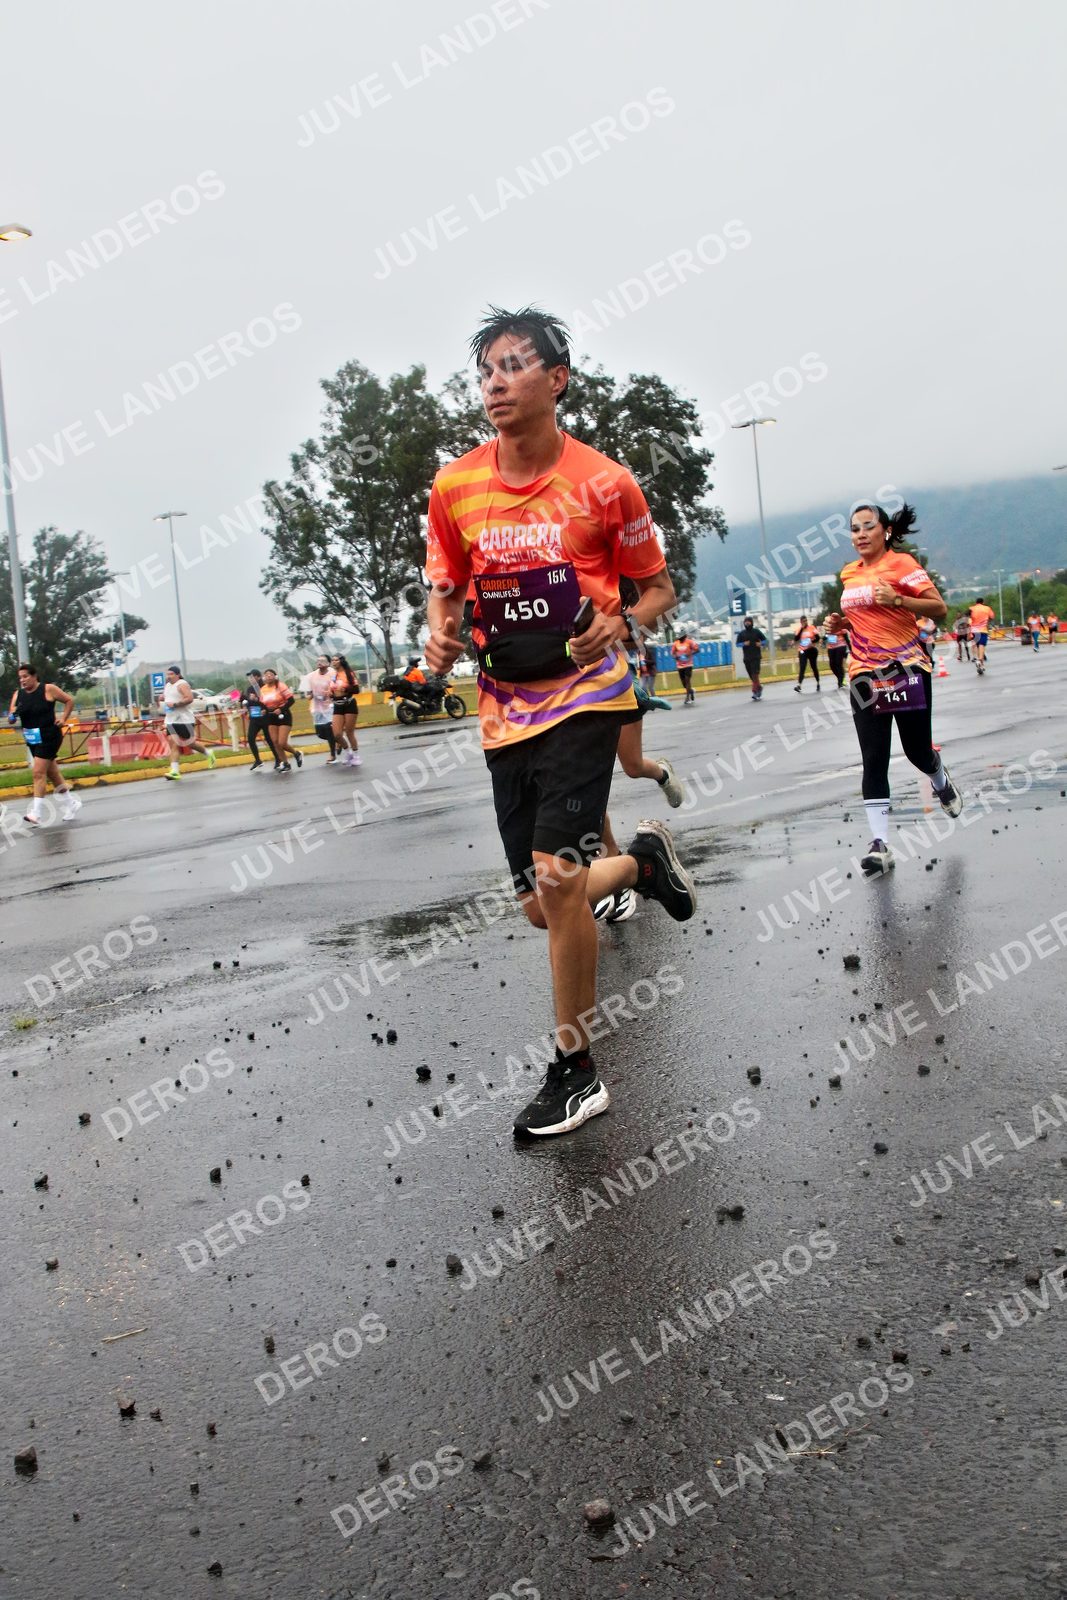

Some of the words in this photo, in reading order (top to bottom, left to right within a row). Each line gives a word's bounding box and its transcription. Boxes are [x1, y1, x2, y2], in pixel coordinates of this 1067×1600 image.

[479, 523, 561, 552] CARRERA
[547, 568, 567, 585] 15K
[480, 578, 519, 591] CARRERA
[504, 598, 550, 621] 450
[733, 600, 742, 613] E
[884, 690, 908, 702] 141
